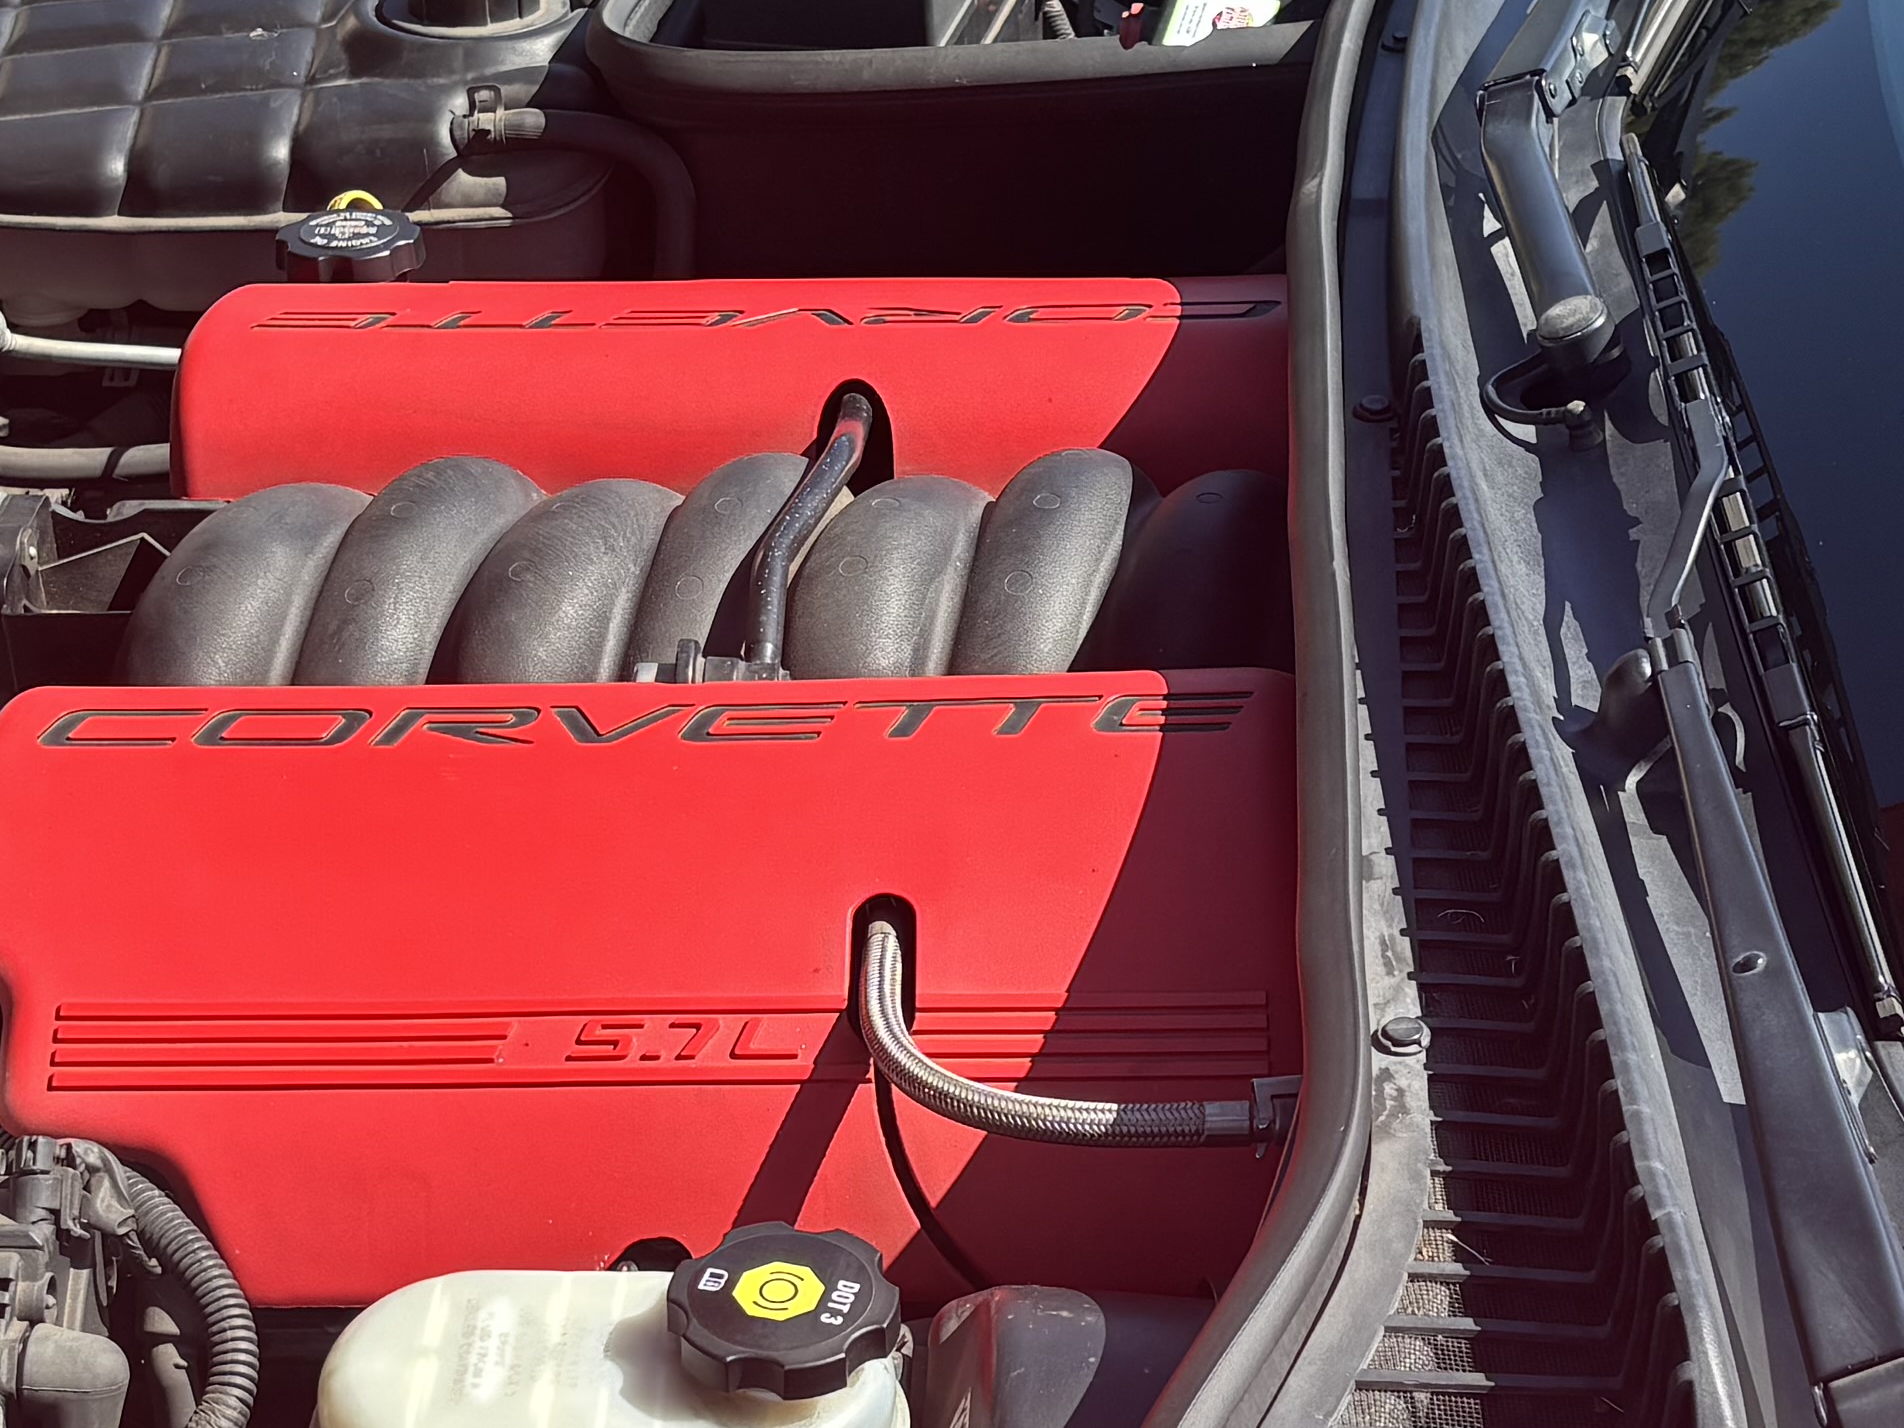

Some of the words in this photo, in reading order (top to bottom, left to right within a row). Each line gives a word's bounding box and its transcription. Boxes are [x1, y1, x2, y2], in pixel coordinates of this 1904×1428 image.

[252, 300, 1281, 331] CORVETTE
[37, 693, 1256, 751] CORVETTE
[564, 1018, 800, 1063] 5.7L
[827, 1280, 861, 1315] DOT
[820, 1312, 844, 1327] 3
